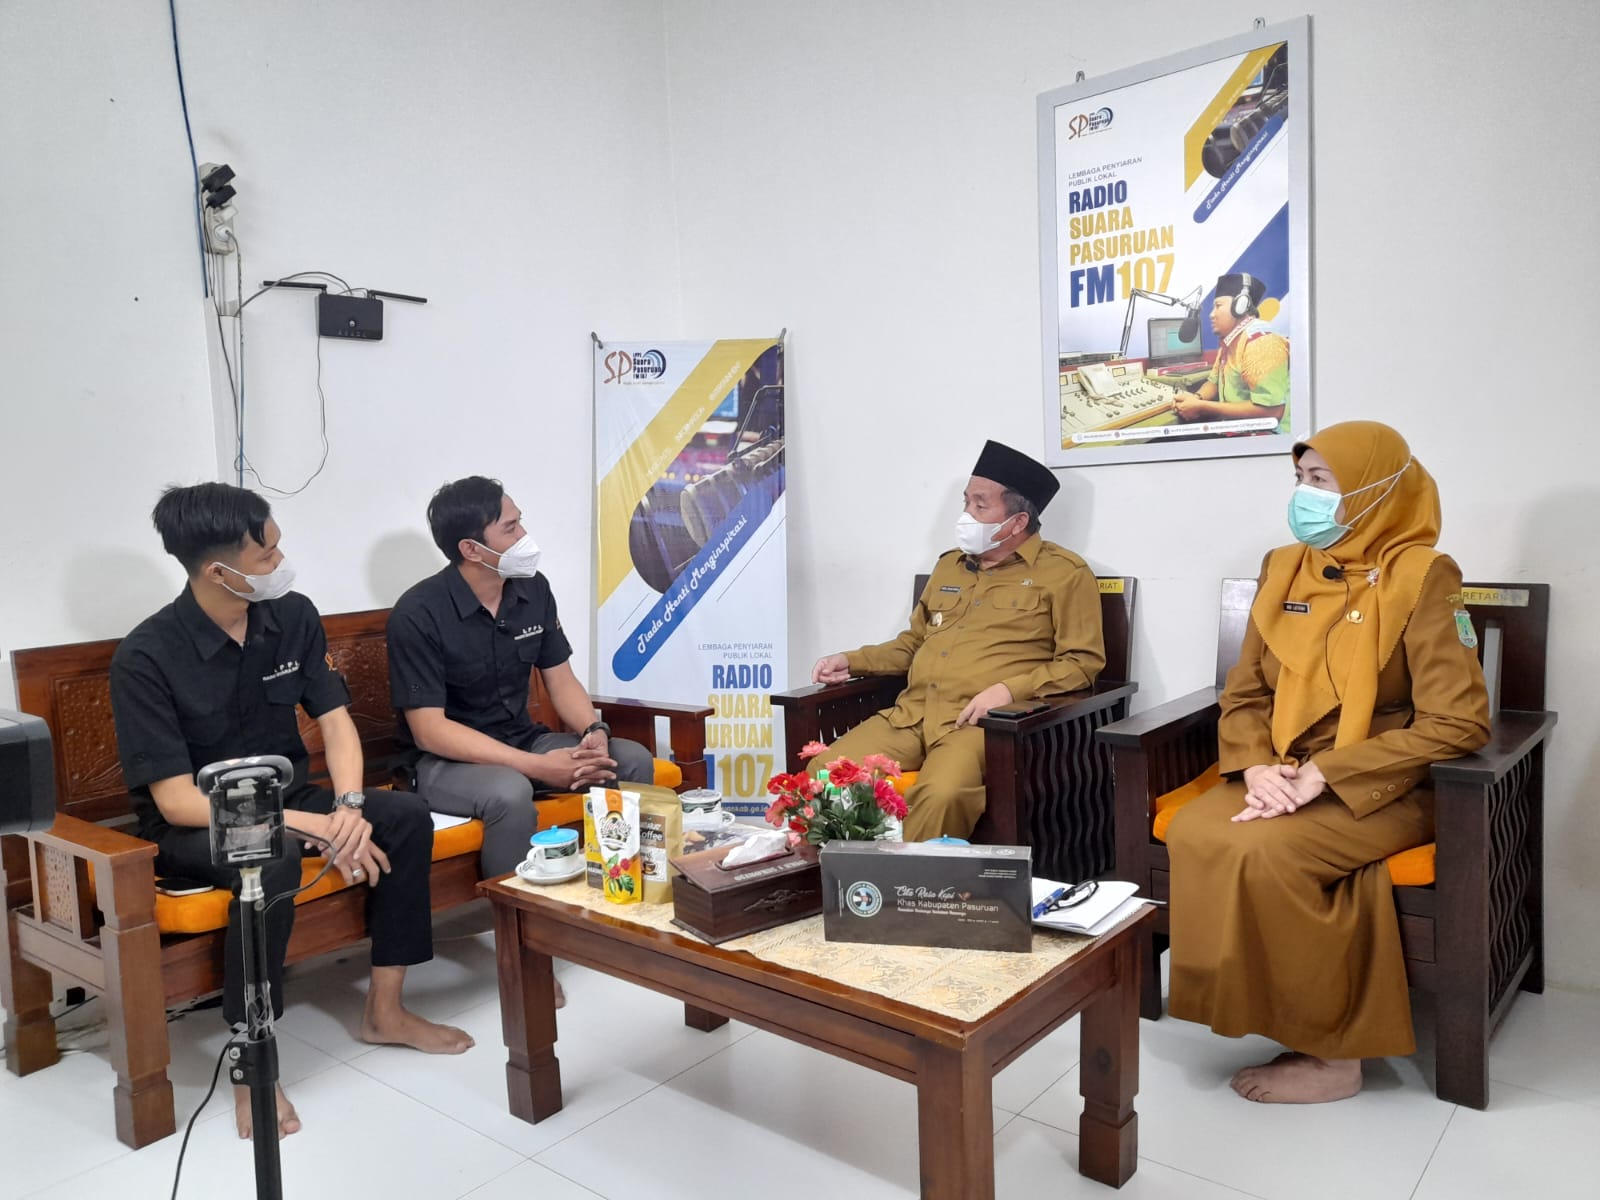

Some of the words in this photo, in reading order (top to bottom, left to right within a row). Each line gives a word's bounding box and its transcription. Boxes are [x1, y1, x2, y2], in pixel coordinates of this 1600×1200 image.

[1069, 166, 1101, 179] LEMBAGA
[1102, 156, 1143, 171] PENYIARAN
[1069, 177, 1092, 187] PUBLIK
[1094, 171, 1117, 182] LOKAL
[1069, 180, 1127, 214] RADIO
[1070, 206, 1134, 240] SUARA
[1070, 224, 1174, 266] PASURUAN
[637, 618, 664, 654] Tiada
[663, 585, 690, 622] Henti
[690, 514, 748, 590] Menginspirasi
[1098, 582, 1119, 590] RIAT
[698, 643, 733, 651] LEMBAGA
[733, 642, 773, 650] PENYIARAN
[712, 663, 772, 689] RADIO
[707, 693, 773, 719] SUARA
[706, 723, 773, 749] URUAN
[703, 753, 774, 797] 107
[640, 830, 663, 841] offee
[897, 899, 916, 907] Khas
[918, 901, 960, 910] Kabupaten
[961, 903, 999, 912] Pasuruan
